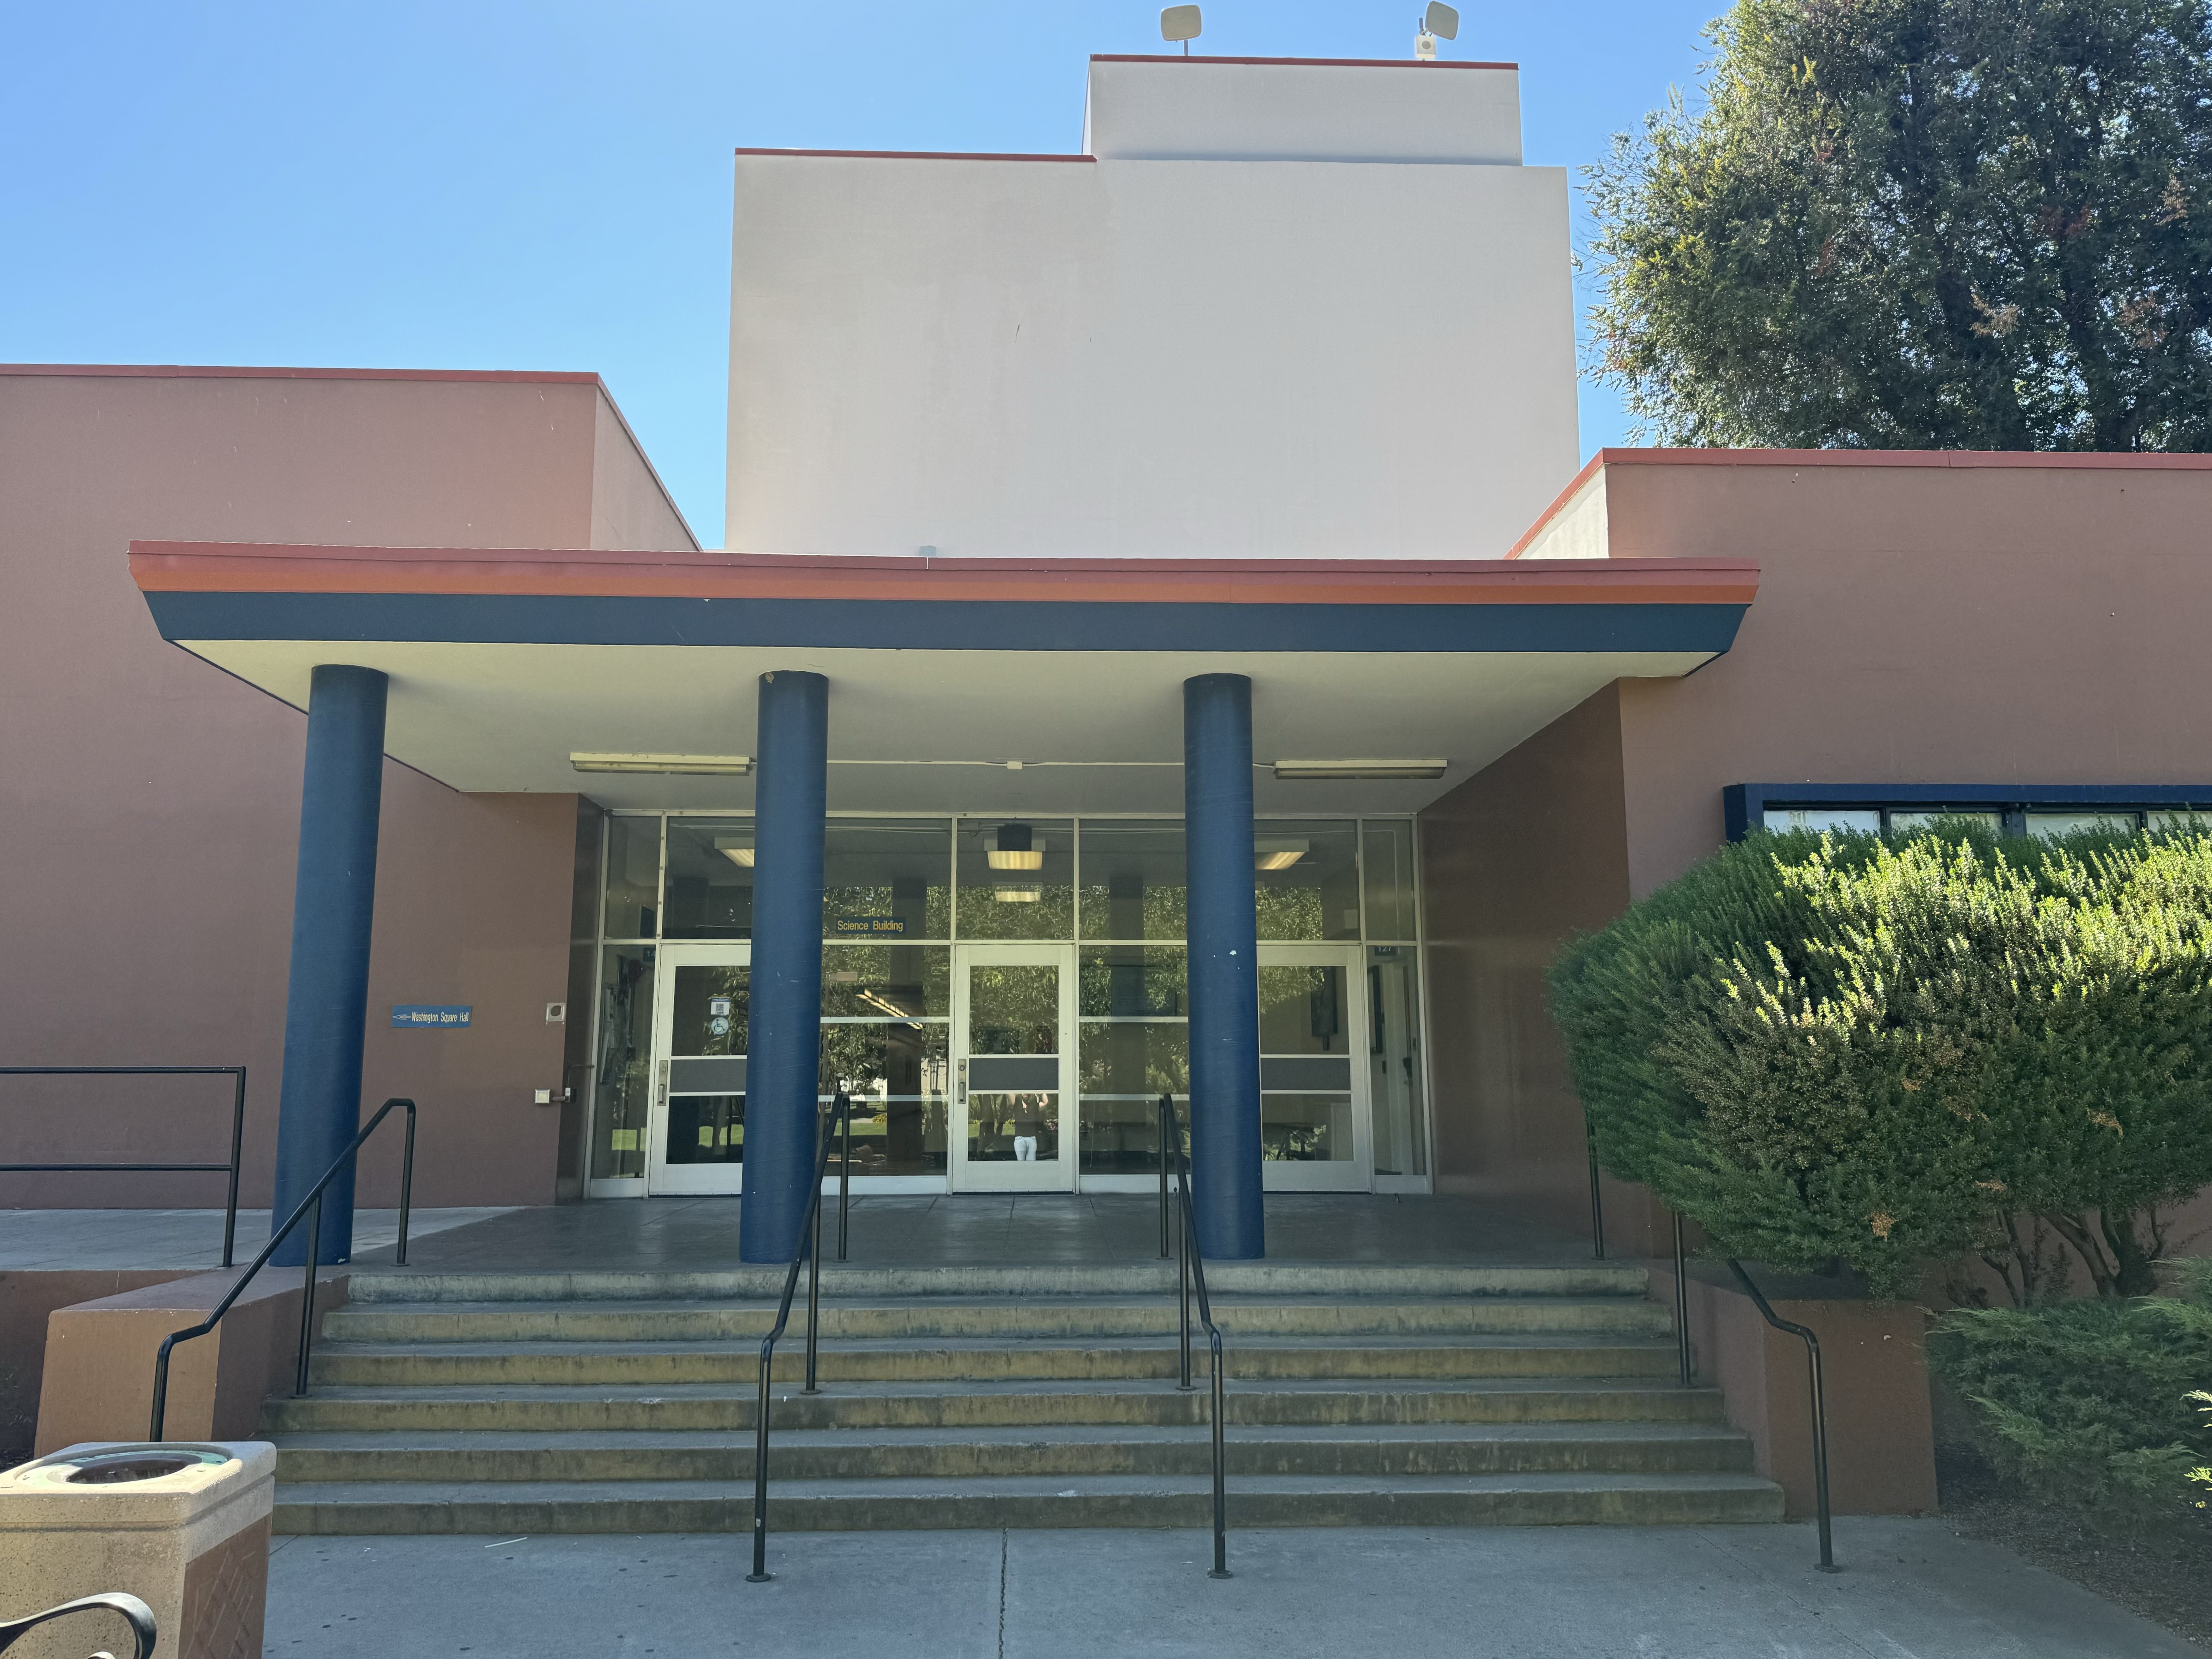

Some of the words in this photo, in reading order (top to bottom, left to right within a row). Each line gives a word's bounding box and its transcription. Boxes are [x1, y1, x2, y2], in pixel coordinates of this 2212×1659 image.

[838, 920, 868, 930] Science
[873, 920, 903, 932] Building
[412, 1012, 438, 1023] Washington
[441, 1012, 457, 1023] Square
[459, 1012, 469, 1022] Hall
